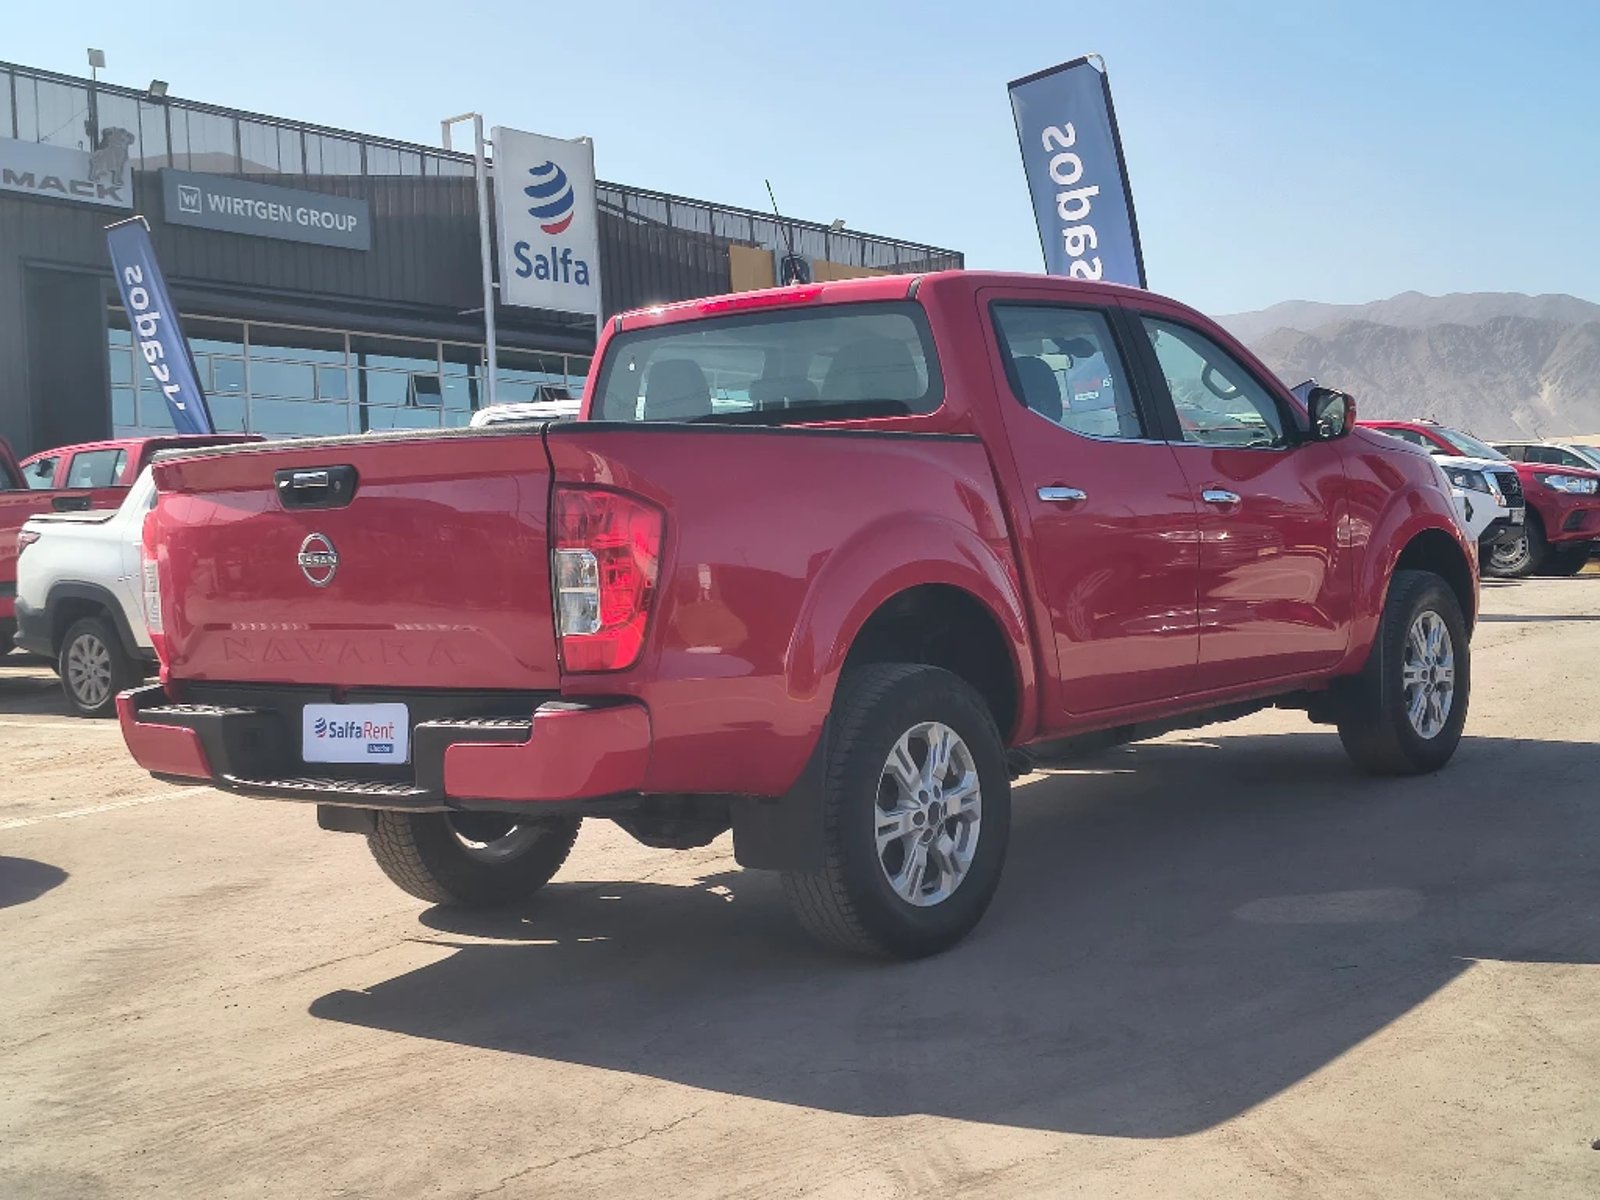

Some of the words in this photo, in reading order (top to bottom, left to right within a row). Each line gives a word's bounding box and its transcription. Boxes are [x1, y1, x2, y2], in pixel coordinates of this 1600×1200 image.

[2, 168, 124, 202] MACK
[207, 193, 293, 223] WIRTGEN
[295, 207, 358, 232] GROUP
[513, 240, 590, 286] Salfa
[223, 636, 466, 666] NAVARA
[328, 720, 395, 740] SalfaRent
